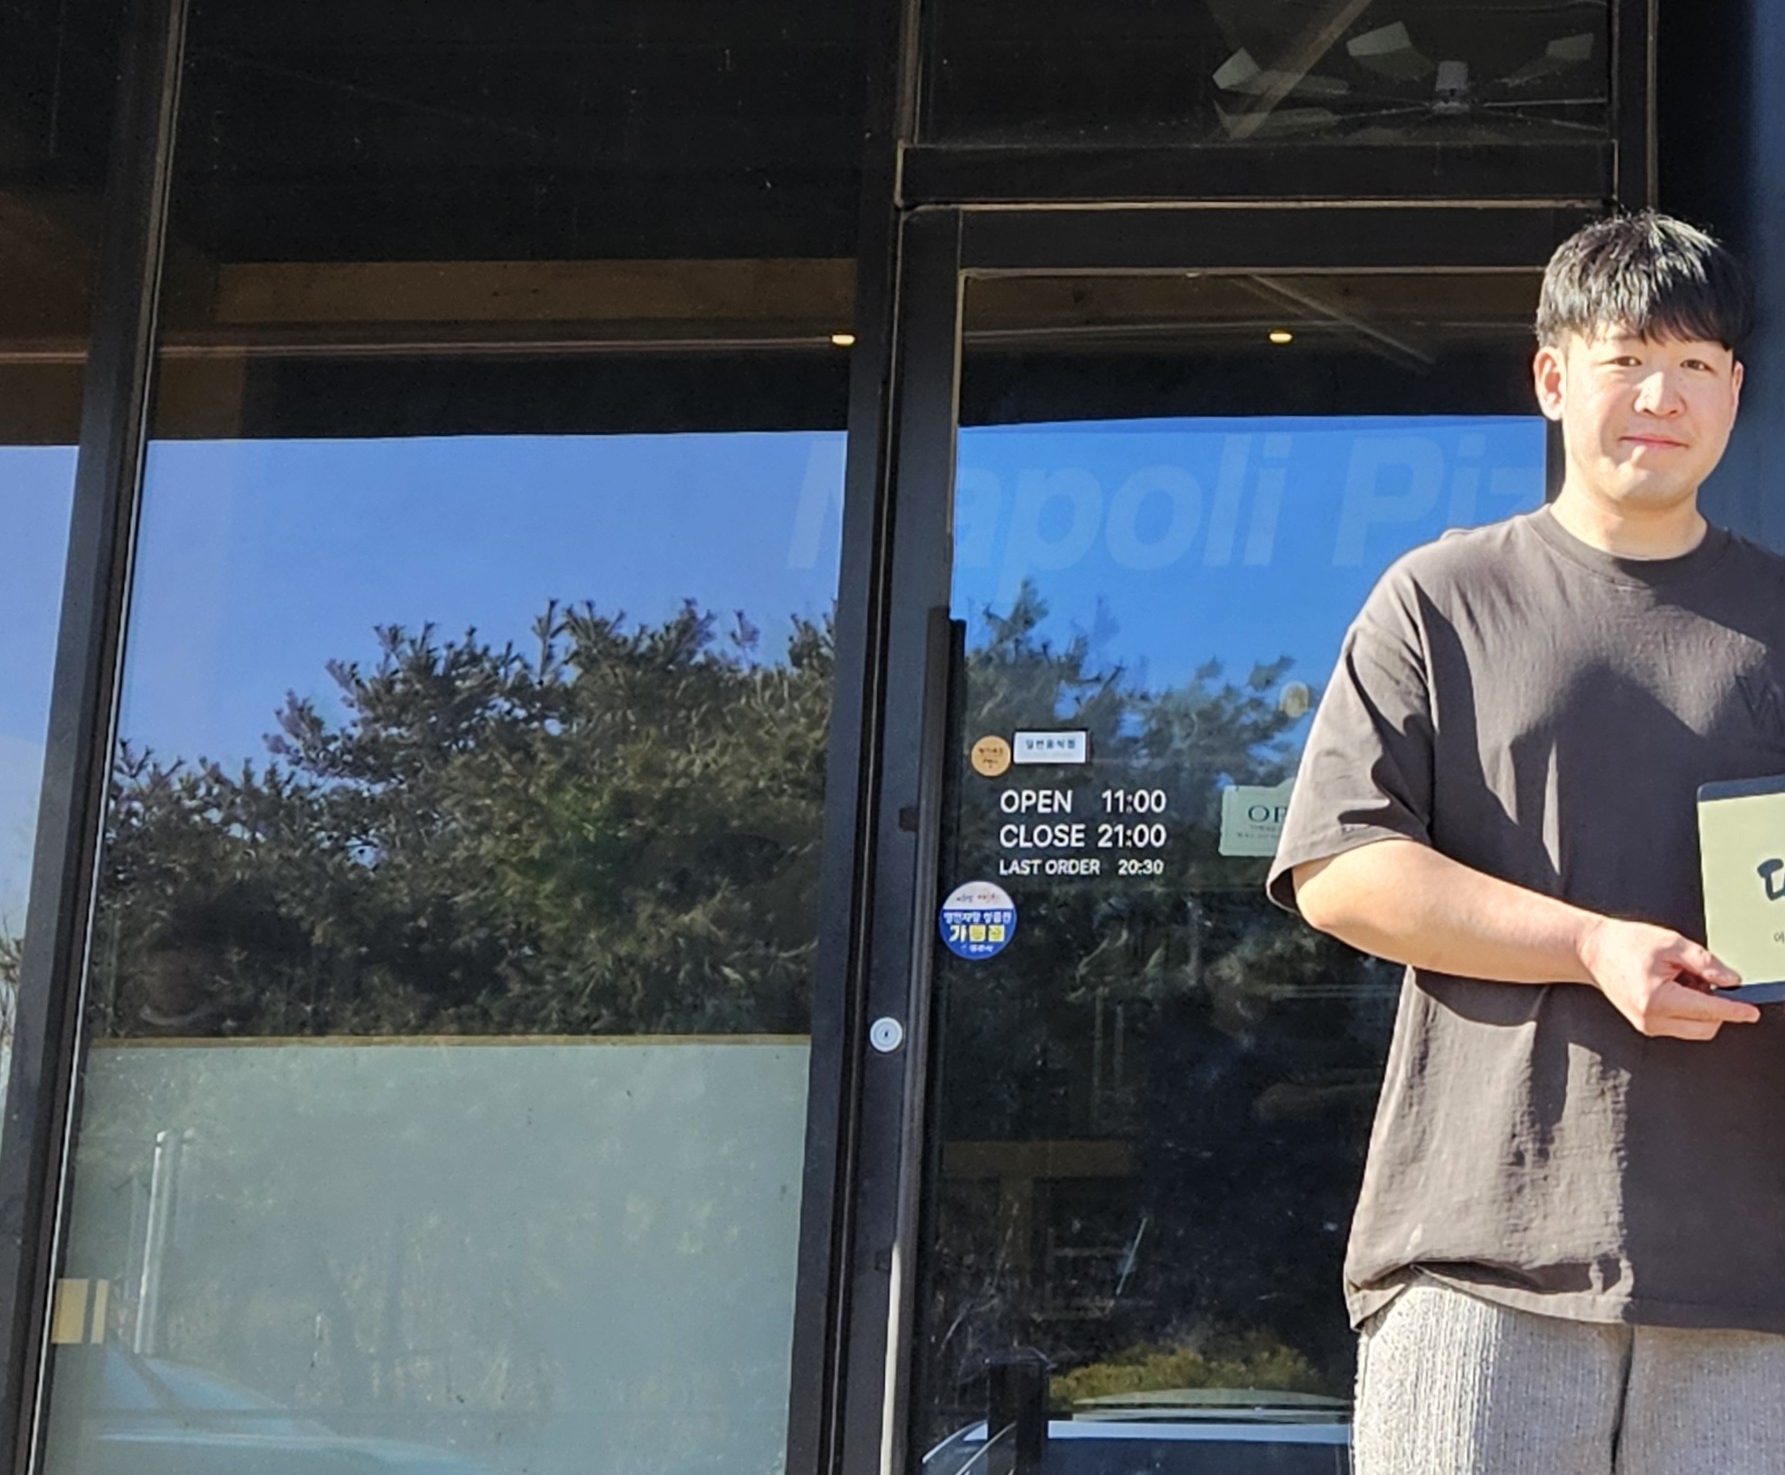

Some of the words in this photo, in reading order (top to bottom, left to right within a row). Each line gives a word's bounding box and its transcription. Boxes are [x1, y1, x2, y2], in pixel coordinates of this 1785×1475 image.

[1000, 789, 1073, 814] OPEN
[1101, 789, 1167, 814] 11:00
[1000, 824, 1085, 849] CLOSE
[1097, 824, 1167, 849] 21:00
[999, 859, 1044, 876] LAST
[1045, 859, 1100, 876] ORDER
[1117, 859, 1164, 876] 20:30
